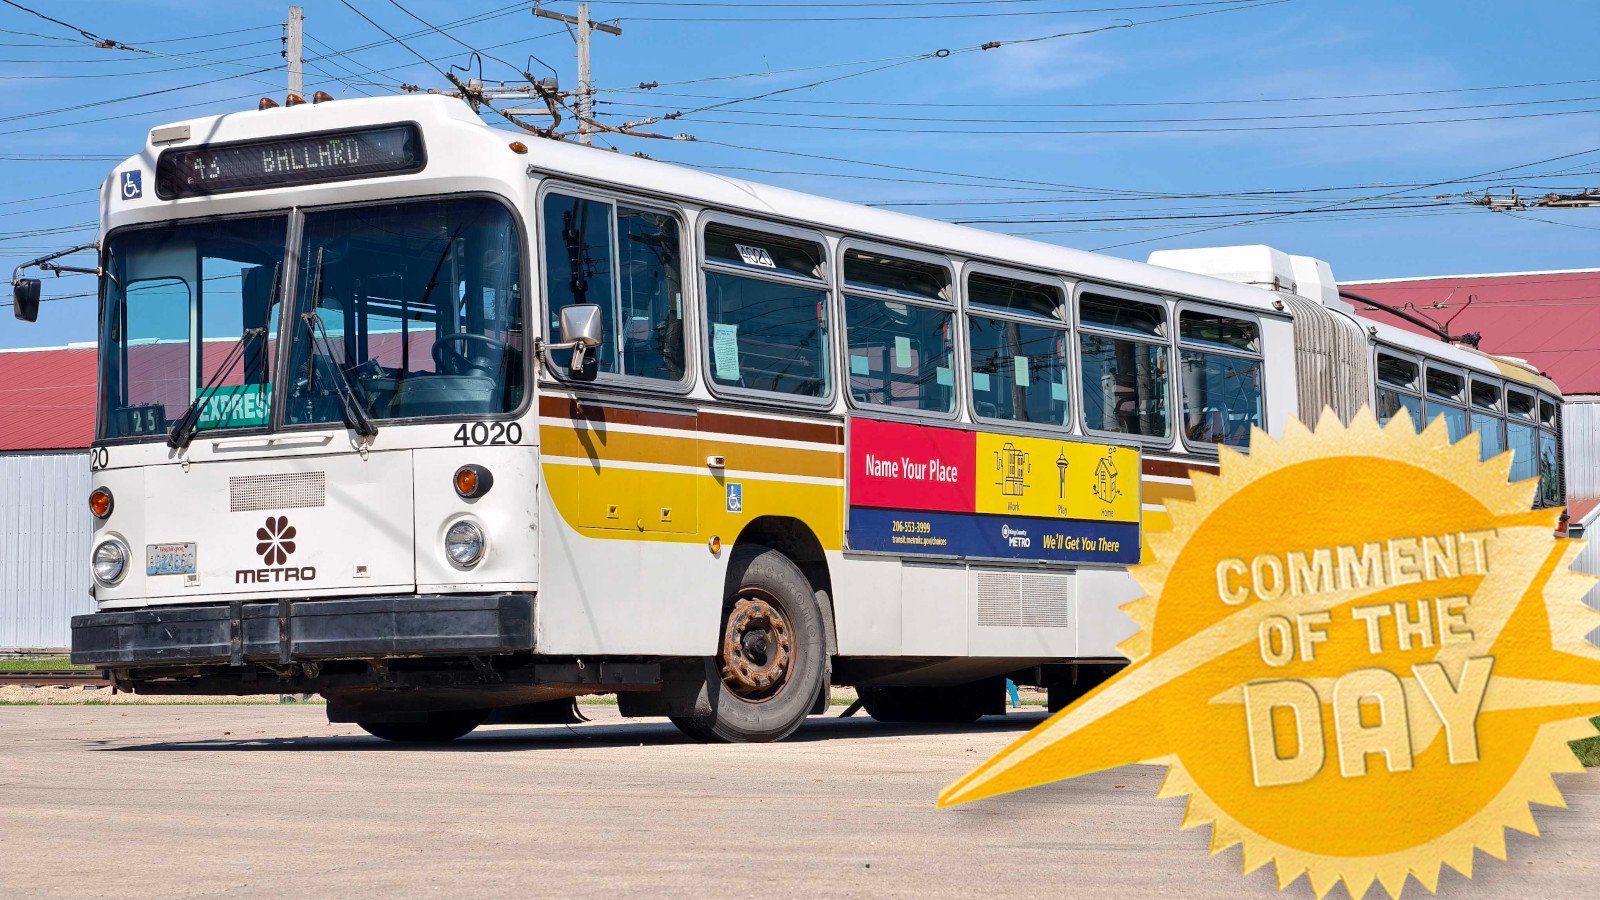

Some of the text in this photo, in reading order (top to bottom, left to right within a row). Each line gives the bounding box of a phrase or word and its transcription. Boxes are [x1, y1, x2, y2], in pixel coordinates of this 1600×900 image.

[262, 138, 361, 173] BALLARD
[740, 245, 774, 267] 4020
[453, 421, 523, 446] 4020
[865, 453, 958, 483] Name Your Place
[1007, 501, 1021, 512] Work
[1057, 504, 1068, 517] Play
[1100, 508, 1114, 518] Home
[892, 520, 931, 533] 206-553-3999
[1008, 536, 1031, 547] METRO
[1043, 533, 1120, 552] We'll Get You There
[235, 566, 316, 584] METRO
